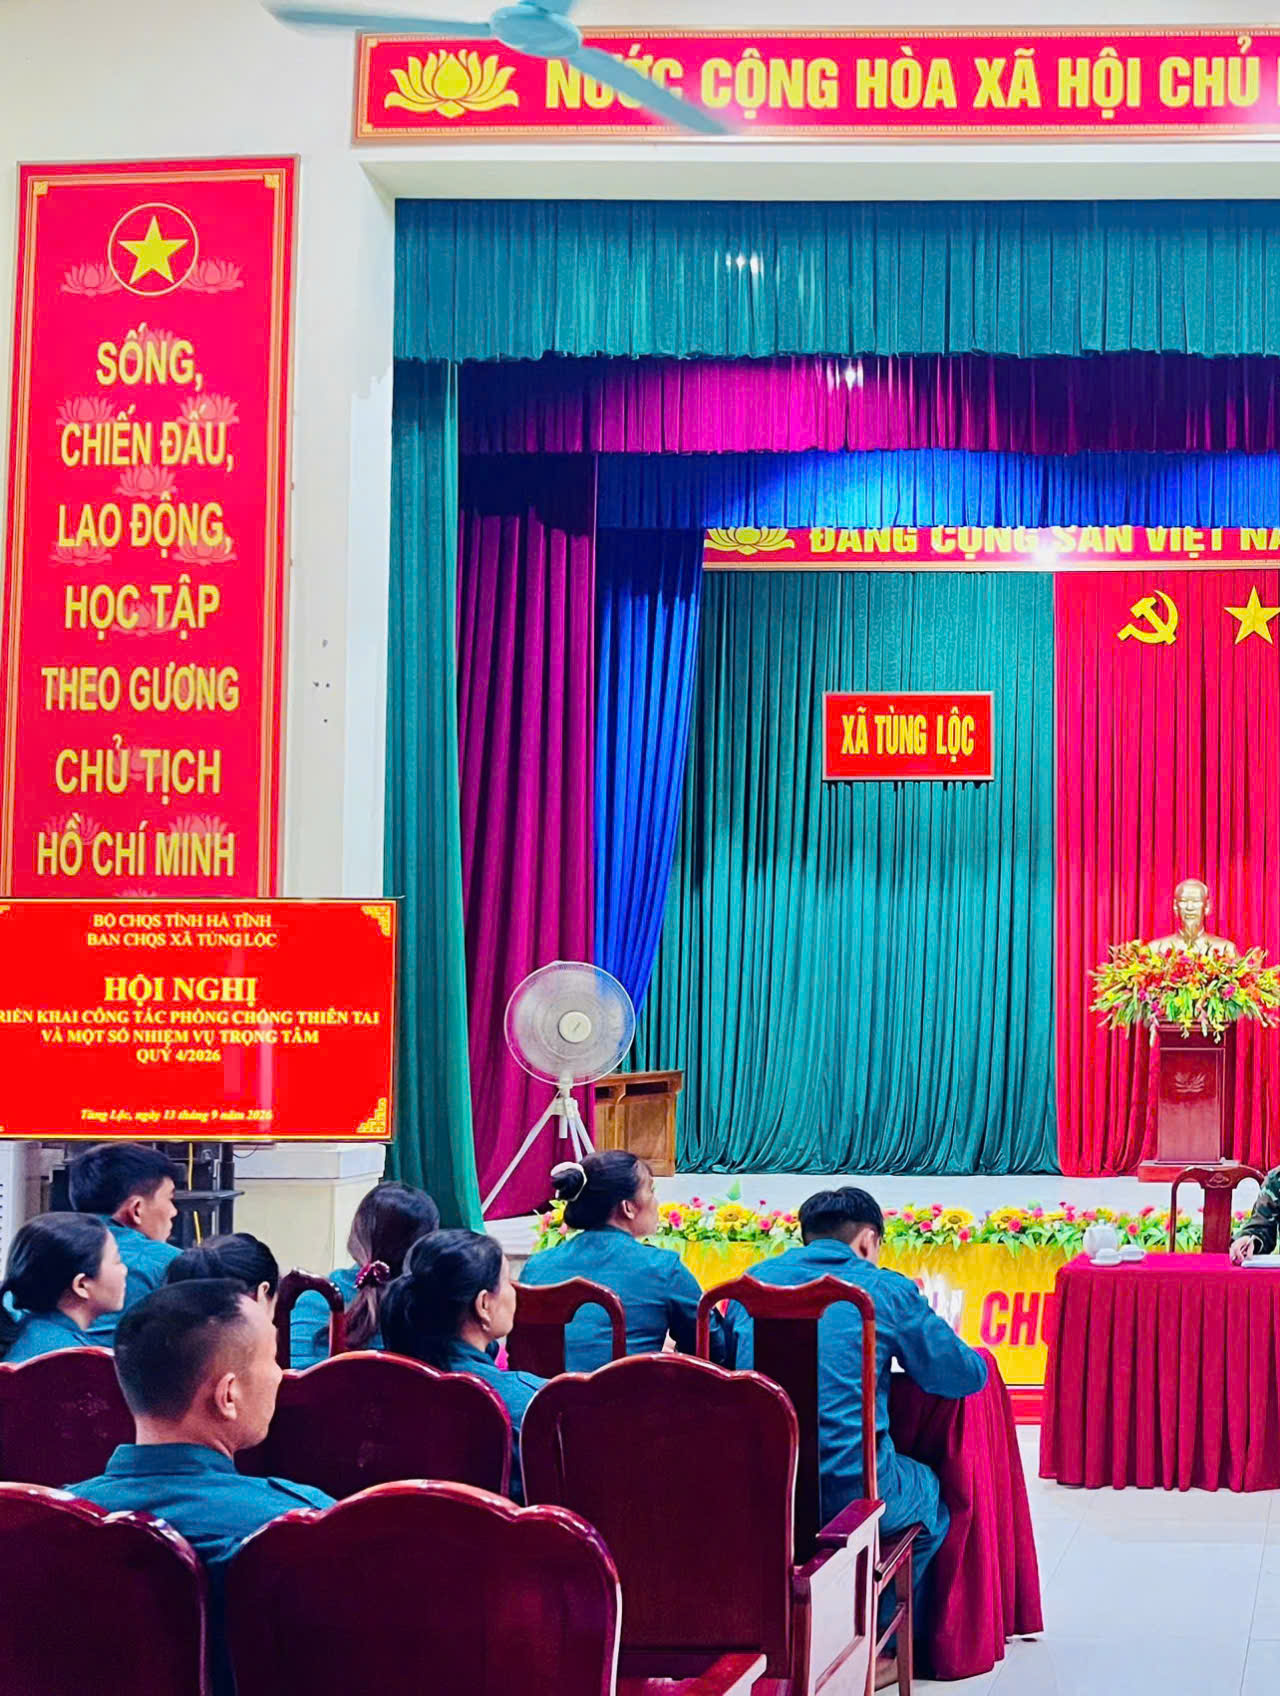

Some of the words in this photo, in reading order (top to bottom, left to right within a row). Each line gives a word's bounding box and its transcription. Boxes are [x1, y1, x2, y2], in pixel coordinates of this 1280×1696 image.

[700, 47, 839, 120] CỘNG
[856, 46, 957, 109] HÒA
[973, 47, 1041, 108] XÃ
[1058, 47, 1141, 119] HỘI
[1158, 34, 1260, 107] CHỦ
[96, 322, 202, 391] SỐNG,
[61, 404, 152, 466] CHIẾN
[160, 403, 233, 472] ĐẤU,
[58, 503, 121, 547] LAO
[130, 490, 231, 558] ĐỘNG,
[65, 585, 139, 640] HỌC
[151, 574, 220, 640] TẬP
[41, 667, 120, 711] THEO
[129, 662, 239, 711] GƯƠNG
[842, 706, 869, 754] XÃ
[874, 705, 927, 755] TÙNG
[936, 706, 975, 763] LỘC
[55, 734, 129, 793] CHỦ
[140, 749, 220, 805] TỊCH
[38, 813, 82, 876] HỒ
[92, 820, 147, 876] CHÍ
[155, 832, 234, 876] MINH
[87, 932, 121, 946] BAN
[123, 932, 167, 949] CHQS
[170, 930, 193, 946] XÃ
[196, 931, 242, 947] TÙNG
[244, 932, 277, 948] LỘC
[93, 912, 117, 929] BỘ
[118, 914, 162, 930] CHQS
[206, 912, 231, 928] HÀ
[0, 1007, 33, 1023] RIỂN
[37, 1010, 79, 1024] KHAI
[81, 1007, 130, 1024] CÔNG
[132, 1007, 167, 1024] TÁC
[170, 1007, 230, 1025] PHÒNG
[296, 1007, 348, 1025] THIÊN
[351, 1011, 380, 1025] TAI
[104, 973, 164, 1008] HỘI
[172, 977, 257, 1010] NGHỊ
[41, 1026, 63, 1043] VÀ
[67, 1028, 105, 1046] MỘT
[133, 1028, 189, 1047] NHIỆM
[192, 1029, 215, 1046] VỤ
[219, 1028, 278, 1047] TRỌNG
[280, 1026, 319, 1044] TÂM
[175, 1048, 221, 1062] 4/2026
[163, 1109, 177, 1120] 13
[211, 1109, 219, 1120] 9
[245, 1109, 273, 1122] 2026
